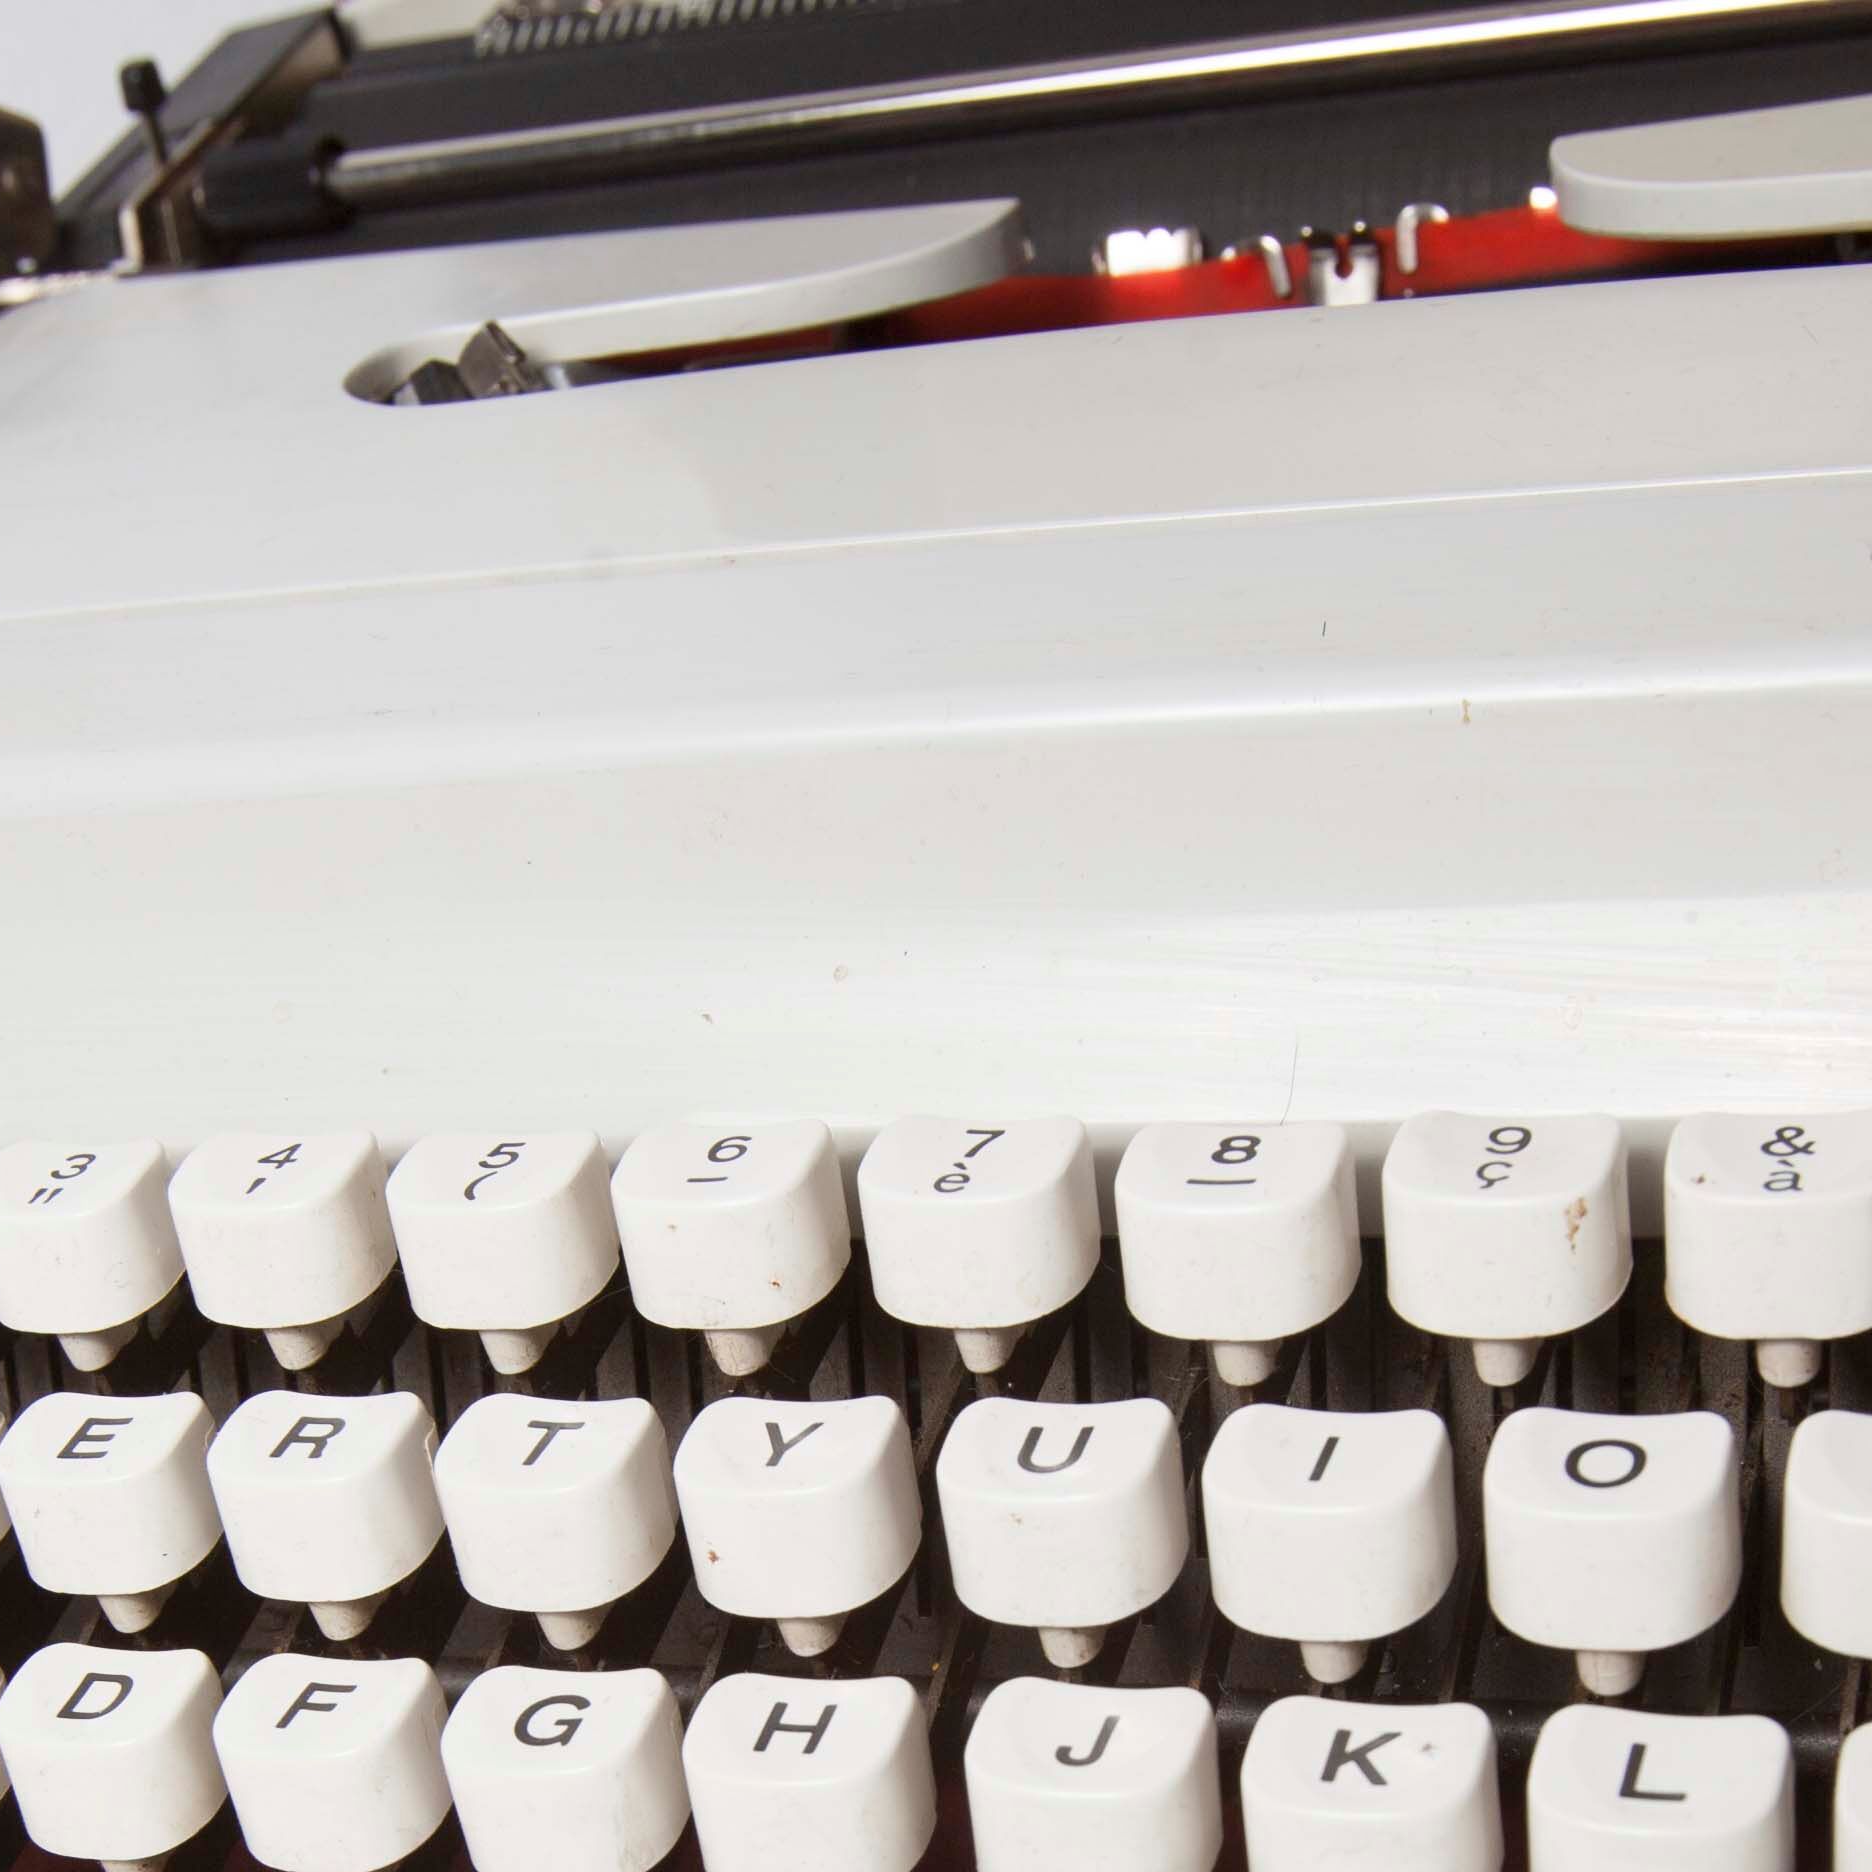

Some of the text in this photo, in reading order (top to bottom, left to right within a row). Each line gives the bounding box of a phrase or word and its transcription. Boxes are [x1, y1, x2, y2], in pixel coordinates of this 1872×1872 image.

[257, 1143, 302, 1169] 4
[478, 1142, 526, 1169] 5
[707, 1135, 752, 1163] 6
[964, 1129, 1006, 1158] 7
[1210, 1135, 1262, 1165] 8
[1485, 1126, 1532, 1155] 9
[1760, 1126, 1815, 1157] &
[50, 1153, 97, 1180] 3
[933, 1162, 971, 1193] è
[1476, 1161, 1513, 1189] ç
[1763, 1159, 1802, 1192] à
[56, 1417, 134, 1460] E
[269, 1416, 346, 1459] R
[522, 1420, 585, 1466] T
[765, 1422, 825, 1467] Y
[1017, 1426, 1095, 1474] U
[1309, 1436, 1340, 1482] I
[1564, 1439, 1647, 1489] O
[56, 1672, 134, 1720] D
[275, 1682, 357, 1729] F
[513, 1694, 591, 1747] G
[753, 1701, 837, 1755] H
[1055, 1716, 1118, 1767] J
[1320, 1729, 1401, 1786] K
[1618, 1743, 1686, 1802] L
